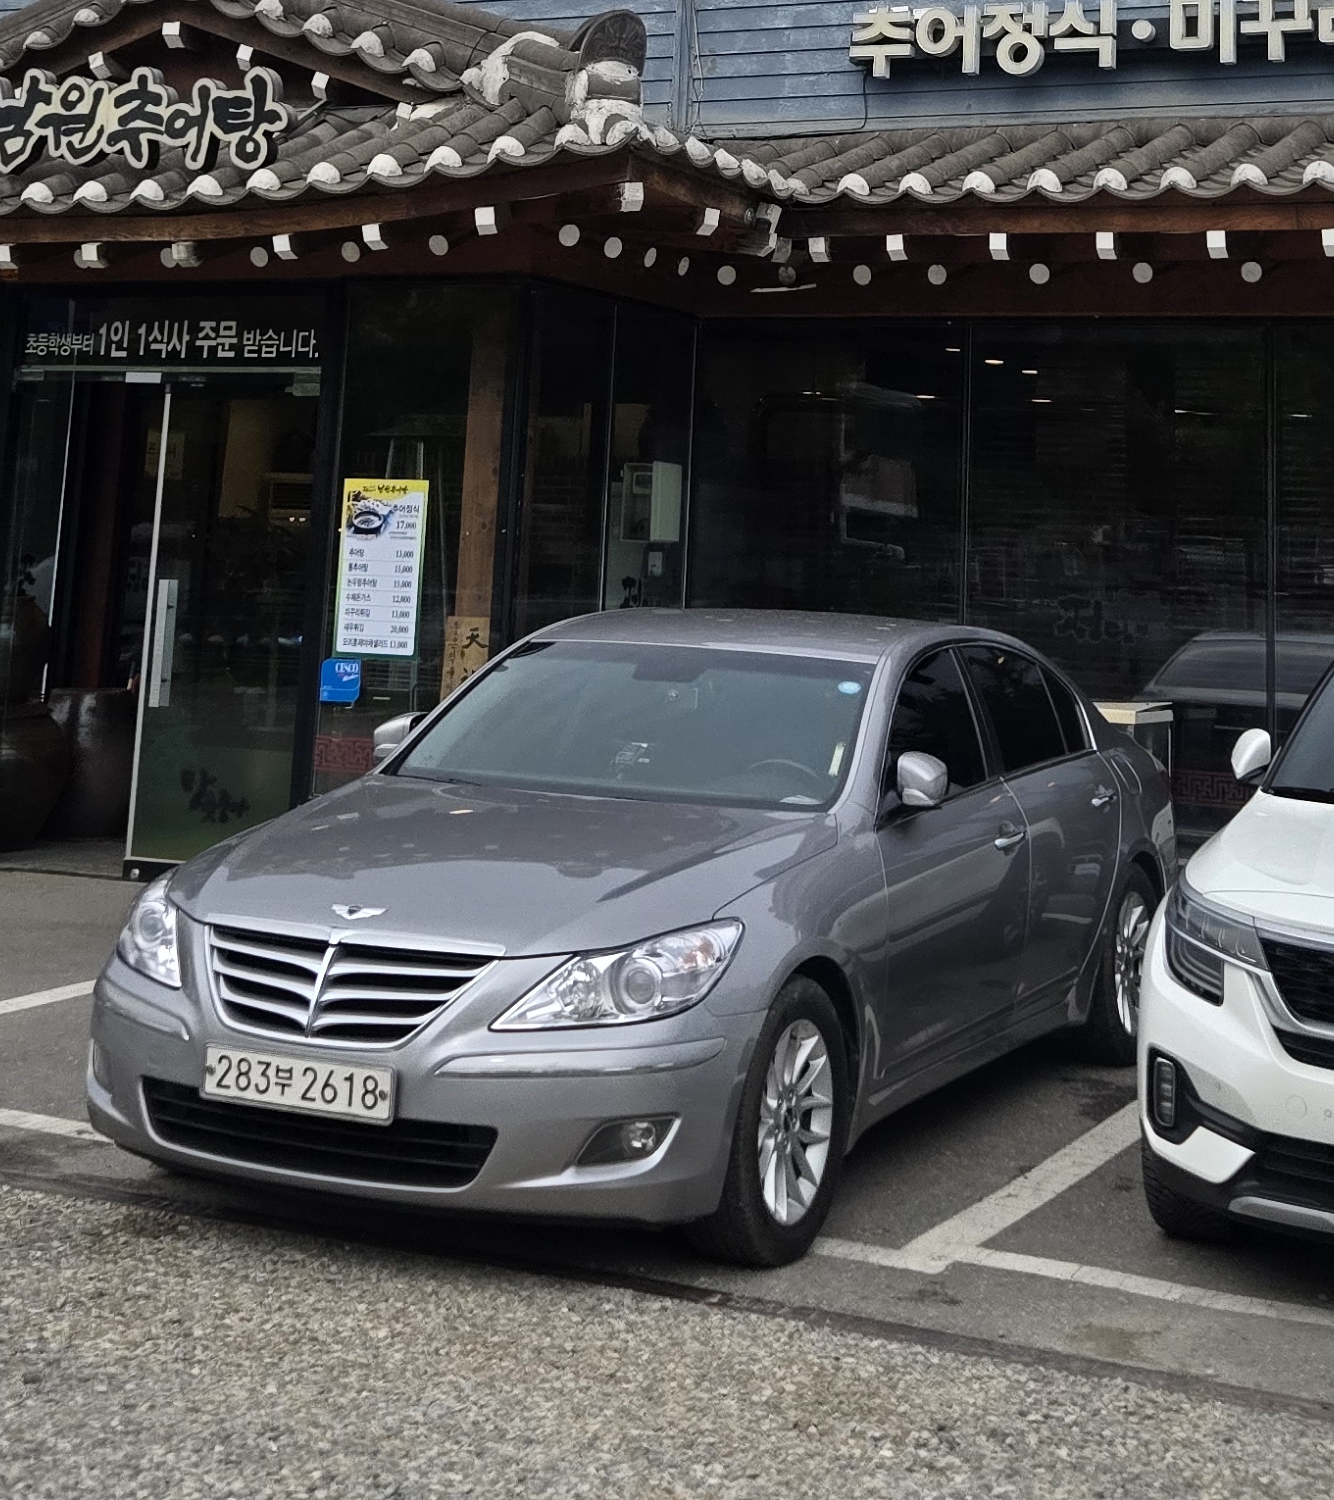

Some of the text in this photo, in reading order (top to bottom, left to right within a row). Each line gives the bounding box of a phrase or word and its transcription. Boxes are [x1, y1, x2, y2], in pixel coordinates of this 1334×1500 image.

[24, 320, 319, 358] 초등학생부터 1인 1식사 주문 받습니다.
[216, 1054, 379, 1110] 283부 2618
